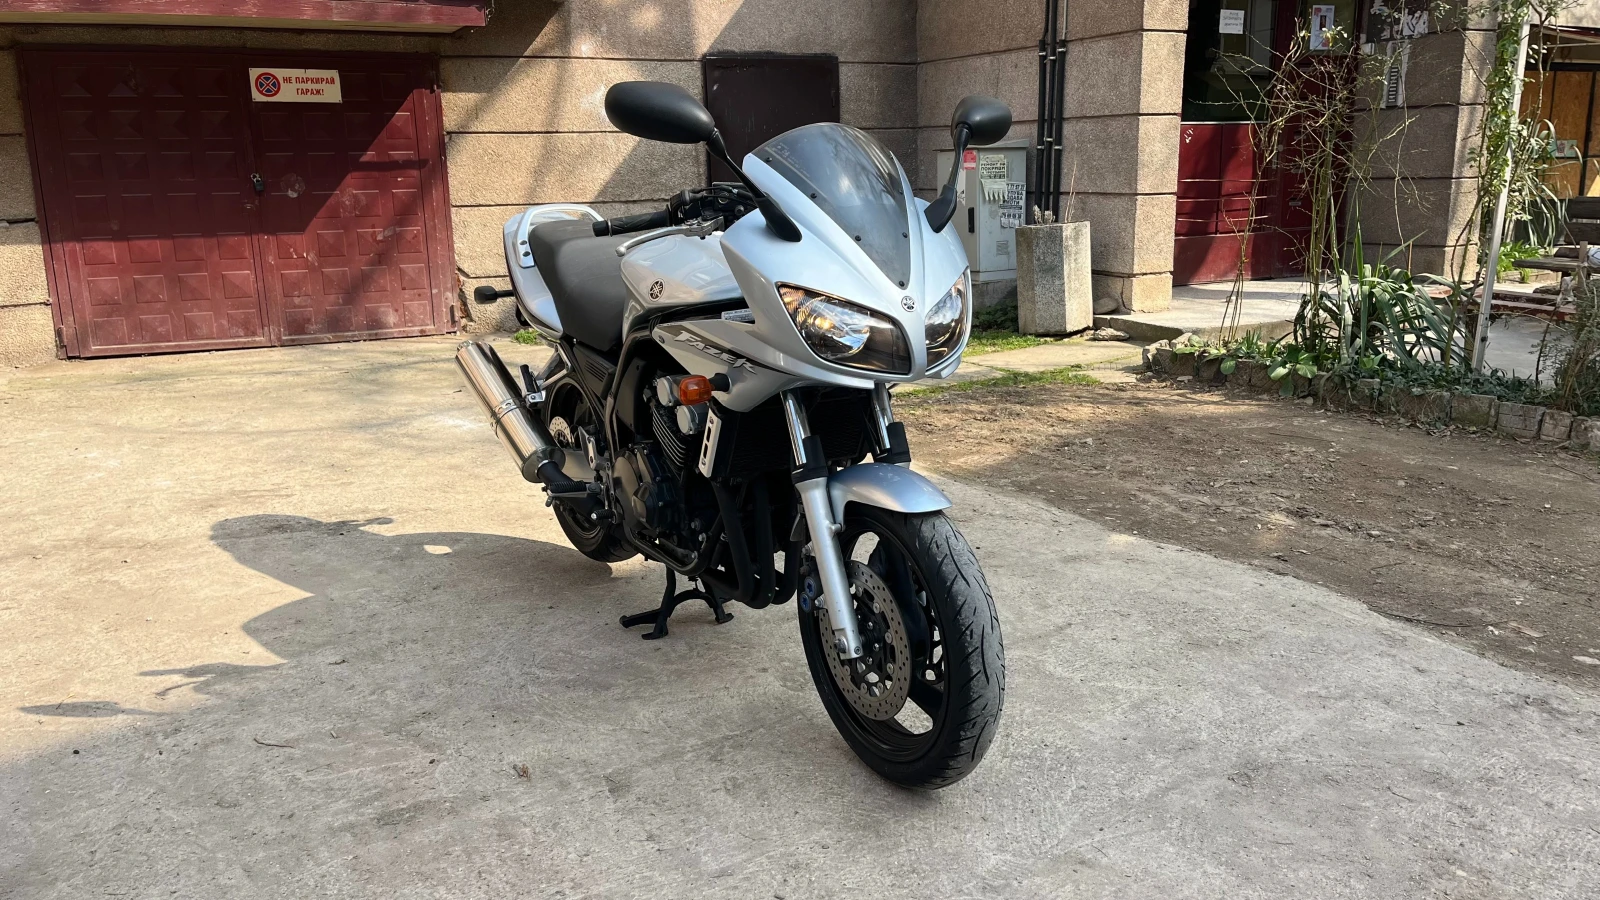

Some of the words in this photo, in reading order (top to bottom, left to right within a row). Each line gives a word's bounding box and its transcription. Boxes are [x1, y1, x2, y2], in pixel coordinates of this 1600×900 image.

[282, 76, 293, 84] НЕ
[295, 76, 335, 85] ПАРКИРАЙ
[296, 88, 325, 96] ГАРАЖ!
[674, 330, 757, 375] FAZER
